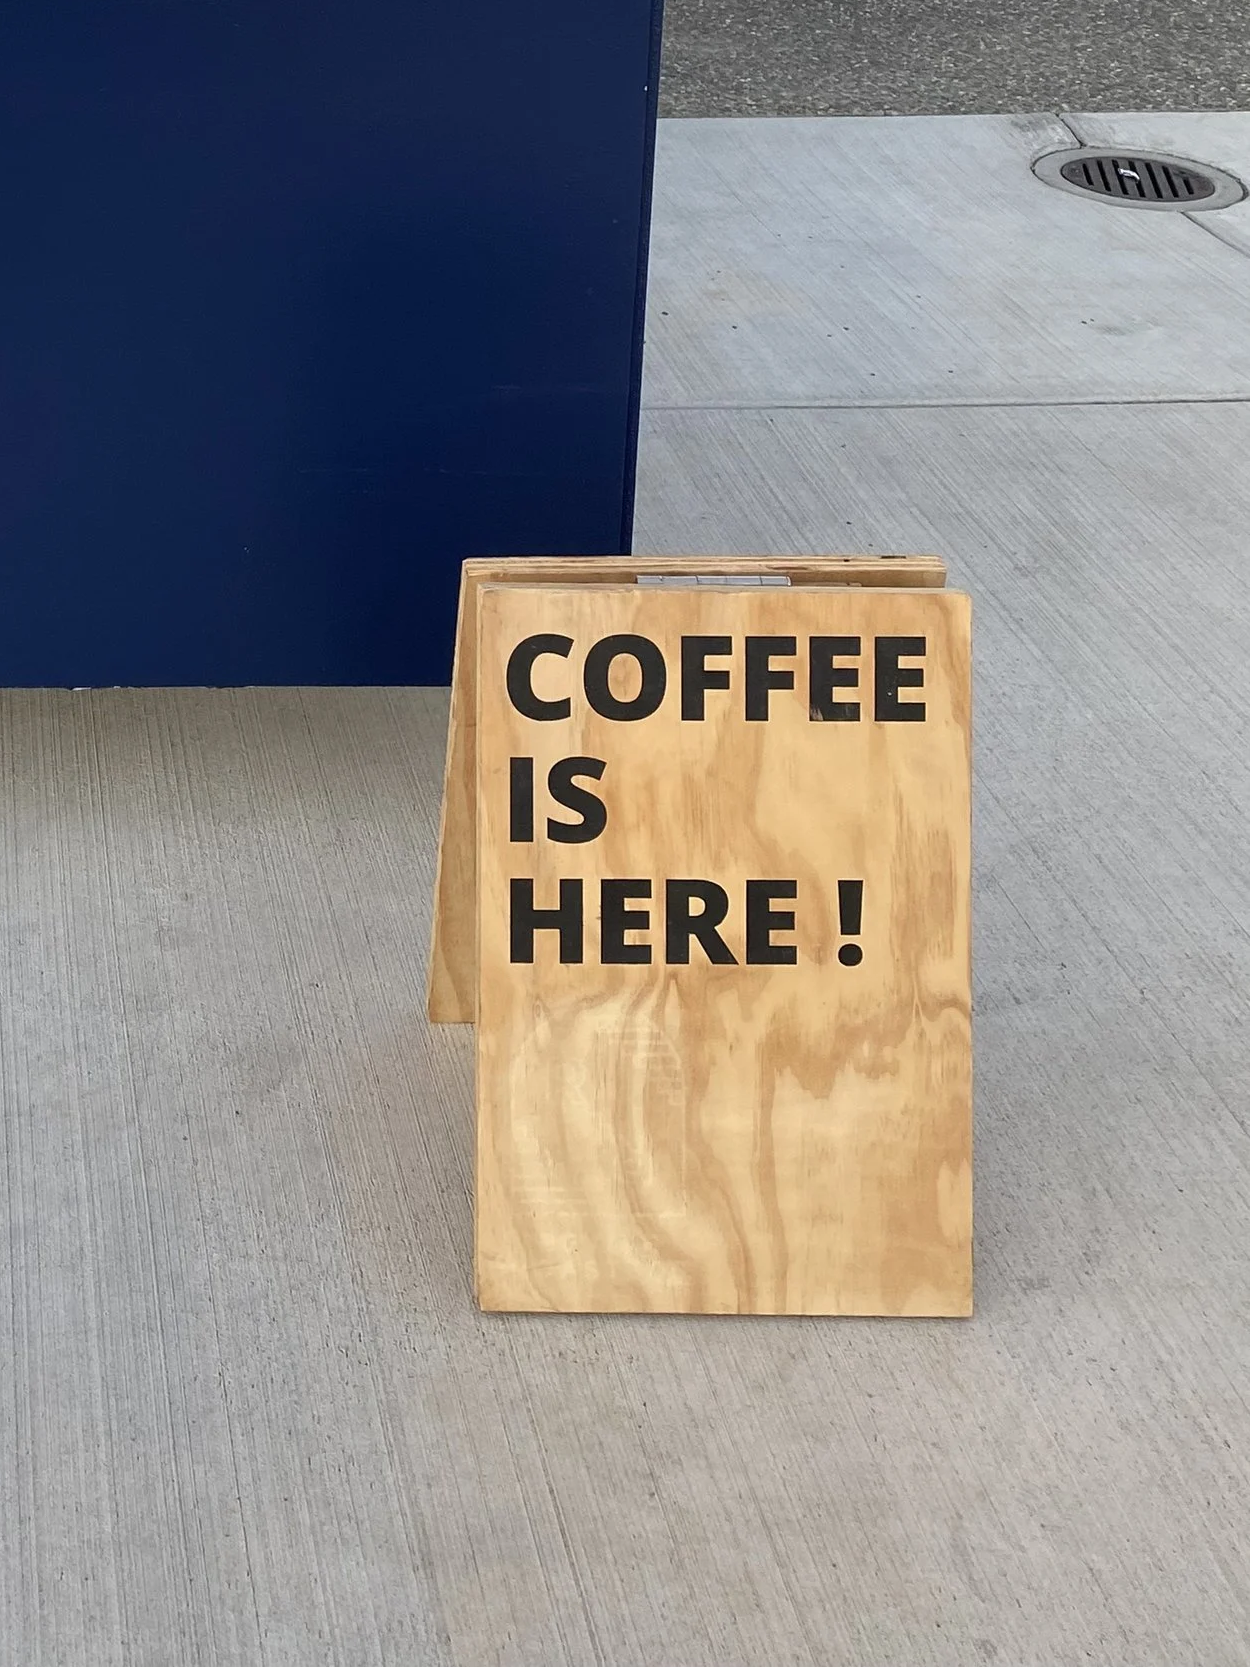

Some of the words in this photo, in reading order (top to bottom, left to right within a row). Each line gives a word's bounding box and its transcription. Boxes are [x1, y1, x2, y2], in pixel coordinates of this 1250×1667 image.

[504, 632, 927, 722] COFFEE
[508, 755, 608, 845] IS
[508, 878, 799, 966] HERE
[837, 879, 866, 968] !
